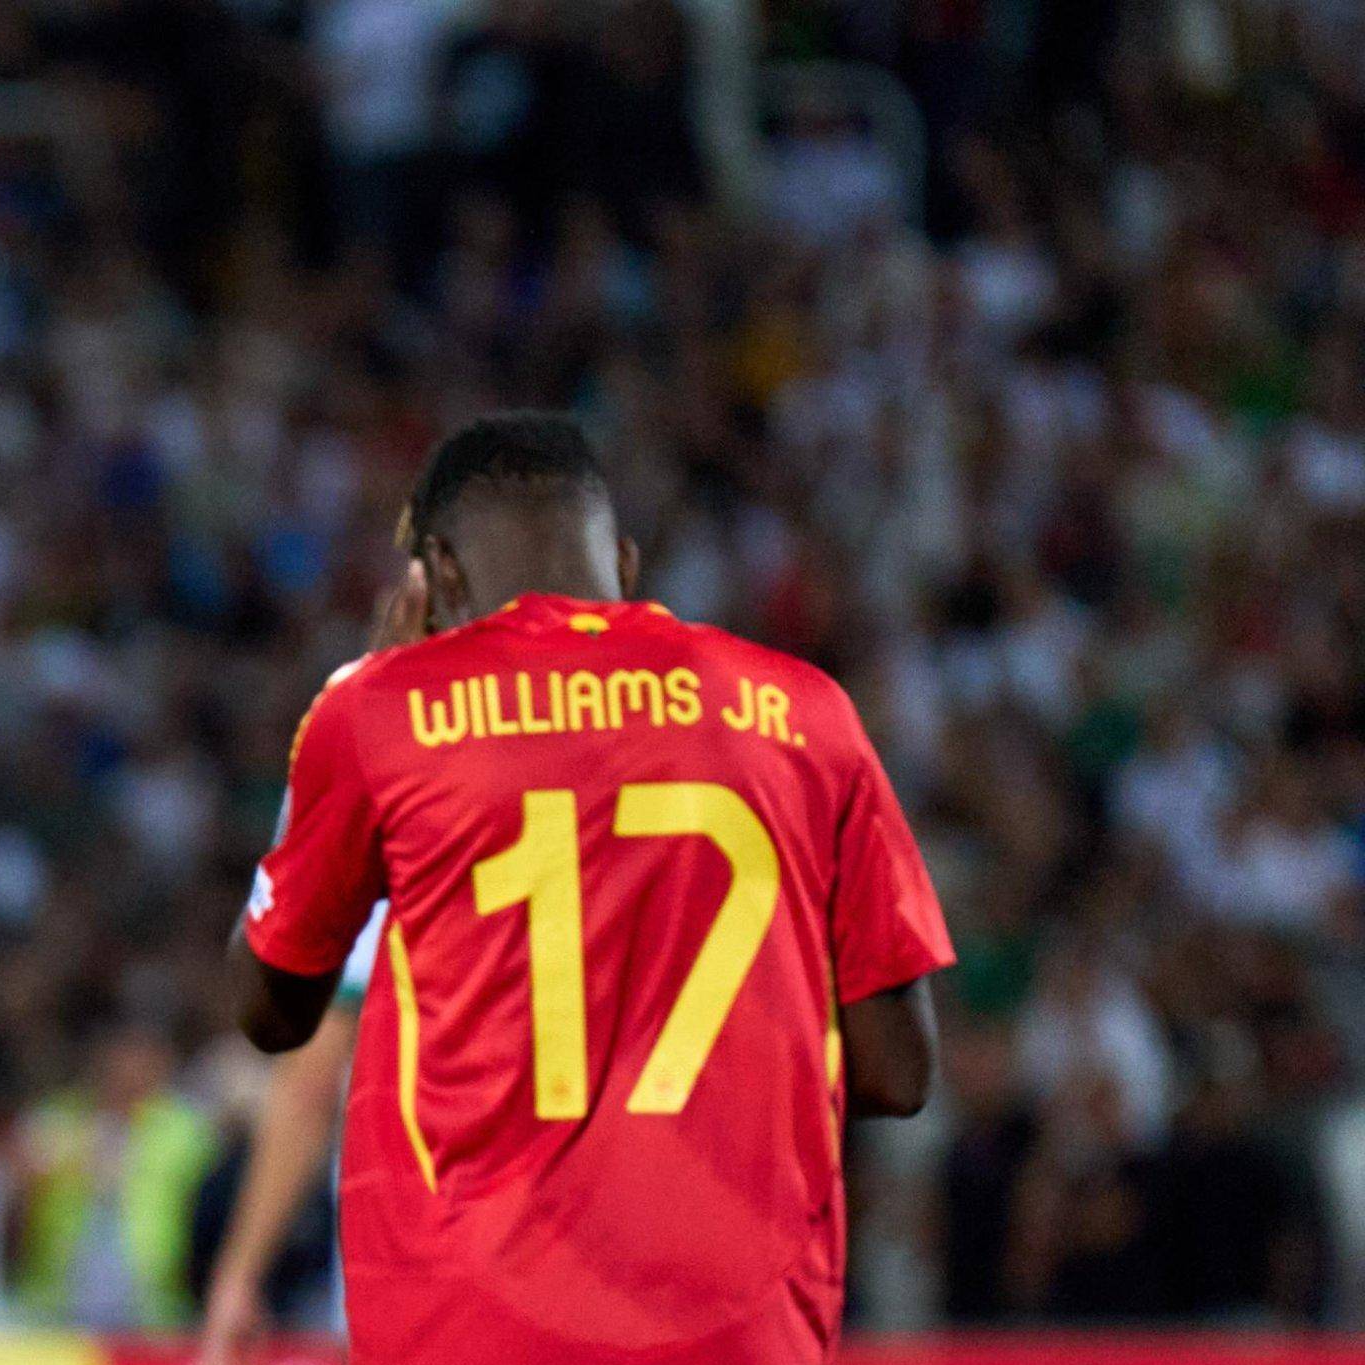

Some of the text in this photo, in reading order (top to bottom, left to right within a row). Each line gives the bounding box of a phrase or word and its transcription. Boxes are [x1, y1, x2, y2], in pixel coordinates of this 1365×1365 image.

[407, 667, 808, 748] WILLIAMS JR.
[472, 781, 782, 1121] 17
